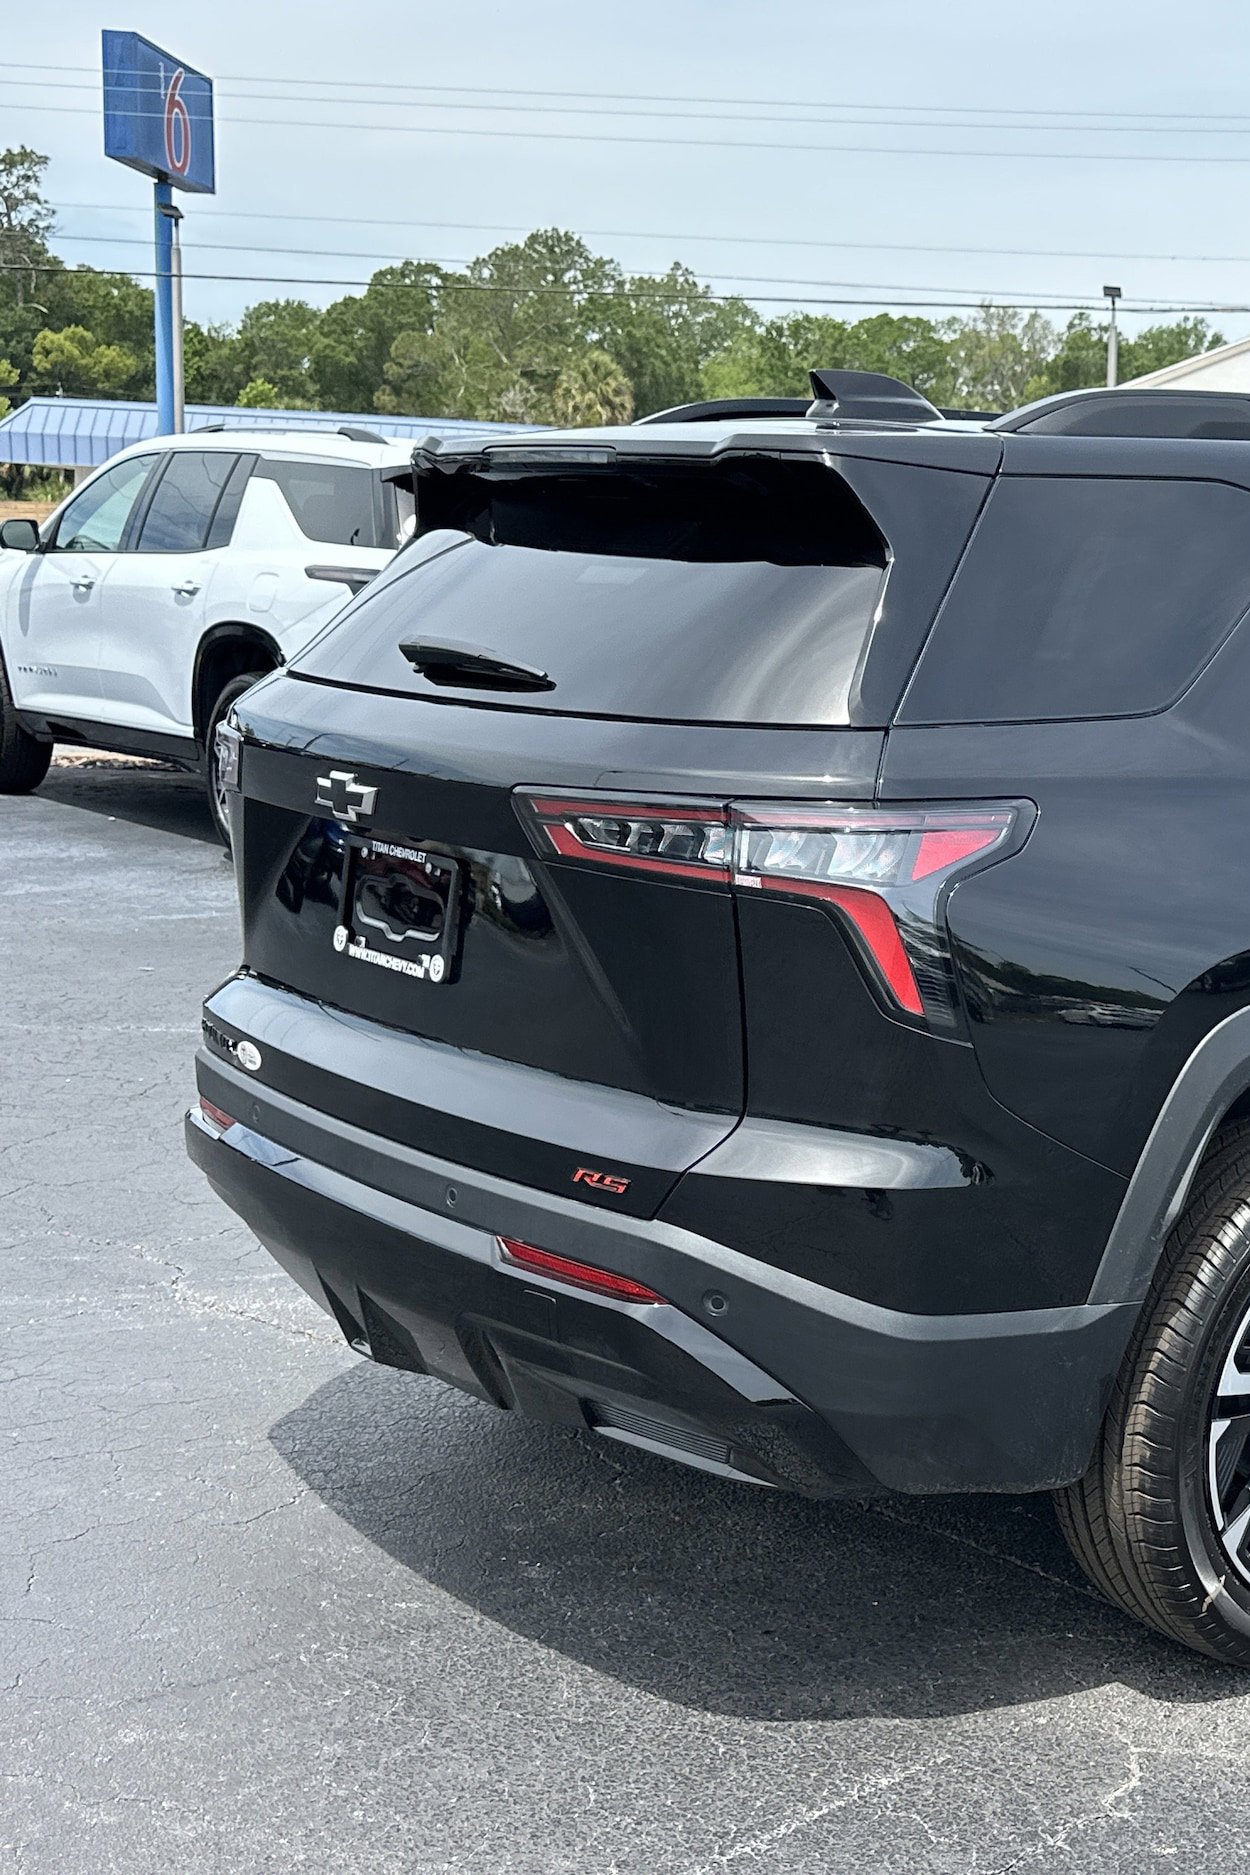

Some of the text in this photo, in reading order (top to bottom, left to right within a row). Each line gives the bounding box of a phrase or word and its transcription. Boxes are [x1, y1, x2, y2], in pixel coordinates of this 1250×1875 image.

[164, 67, 191, 177] 6
[372, 840, 427, 864] TITAN CHEVROLET
[572, 1167, 631, 1194] RS
